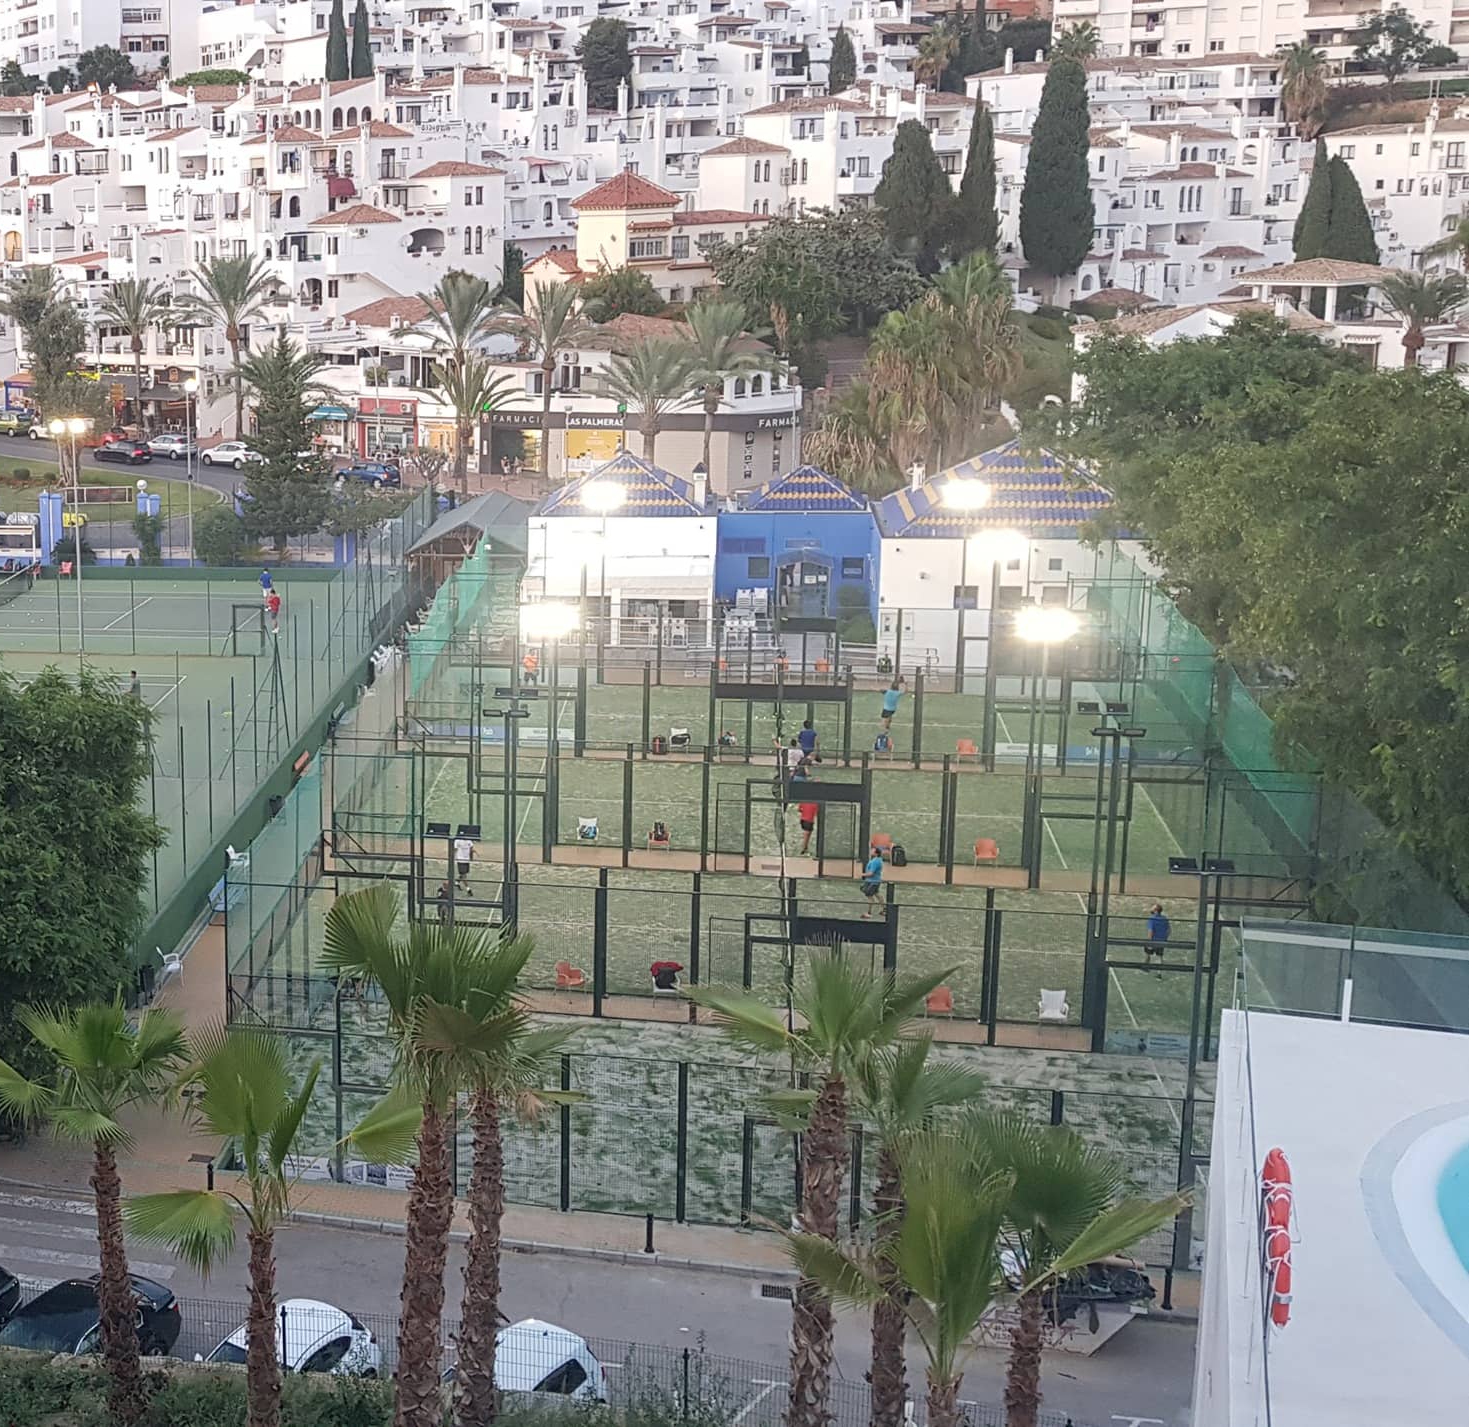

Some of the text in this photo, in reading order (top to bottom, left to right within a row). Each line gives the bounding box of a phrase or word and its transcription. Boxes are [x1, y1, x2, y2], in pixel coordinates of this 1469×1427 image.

[493, 414, 547, 424] FARMACI
[566, 417, 623, 426] LAS PALMERAS
